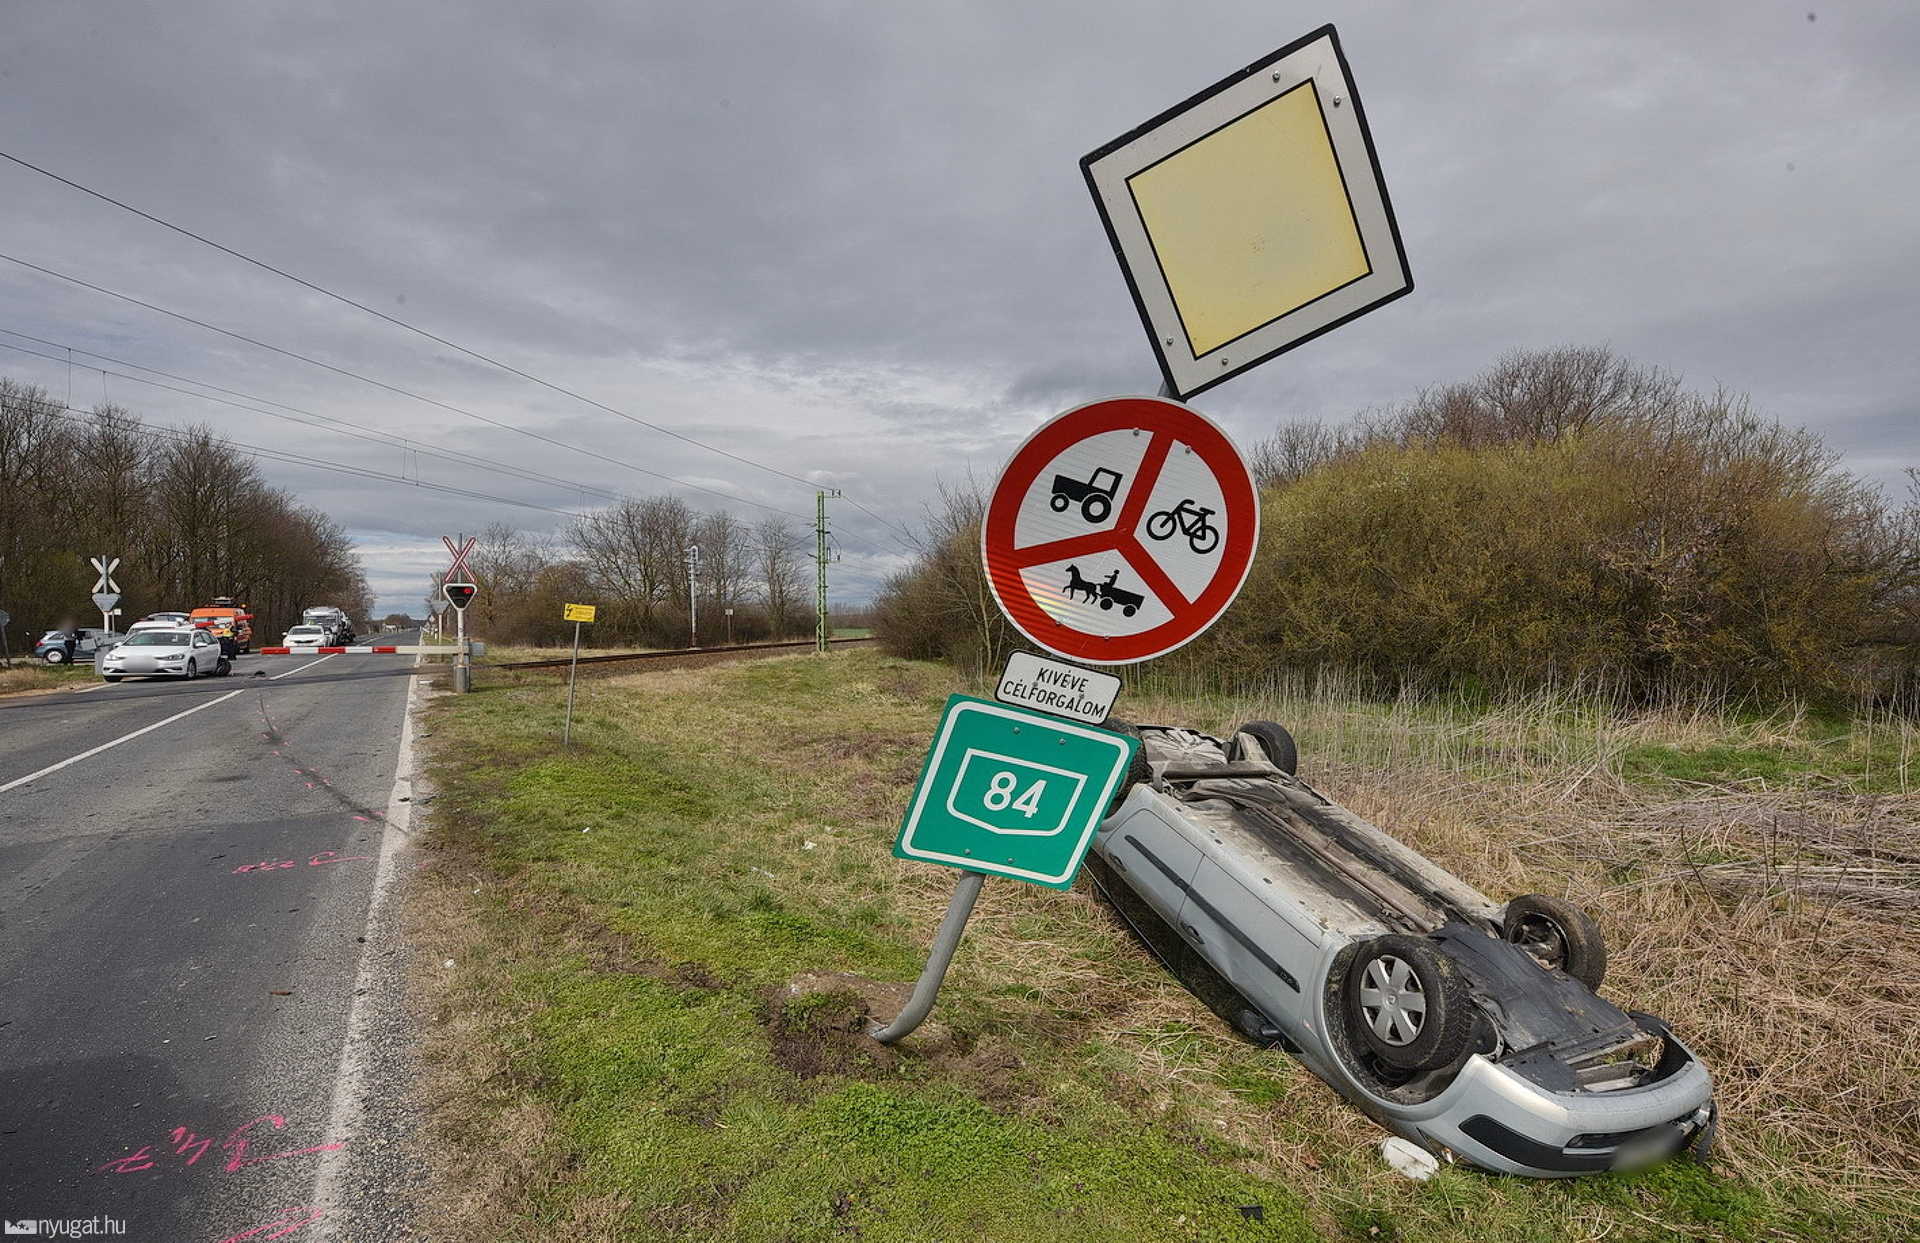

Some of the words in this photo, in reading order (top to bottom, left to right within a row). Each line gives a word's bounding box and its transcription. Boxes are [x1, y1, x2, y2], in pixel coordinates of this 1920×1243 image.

[1003, 678, 1106, 718] CÉLFORGALOM
[1036, 667, 1089, 693] KIVÉVE
[983, 771, 1047, 818] 84
